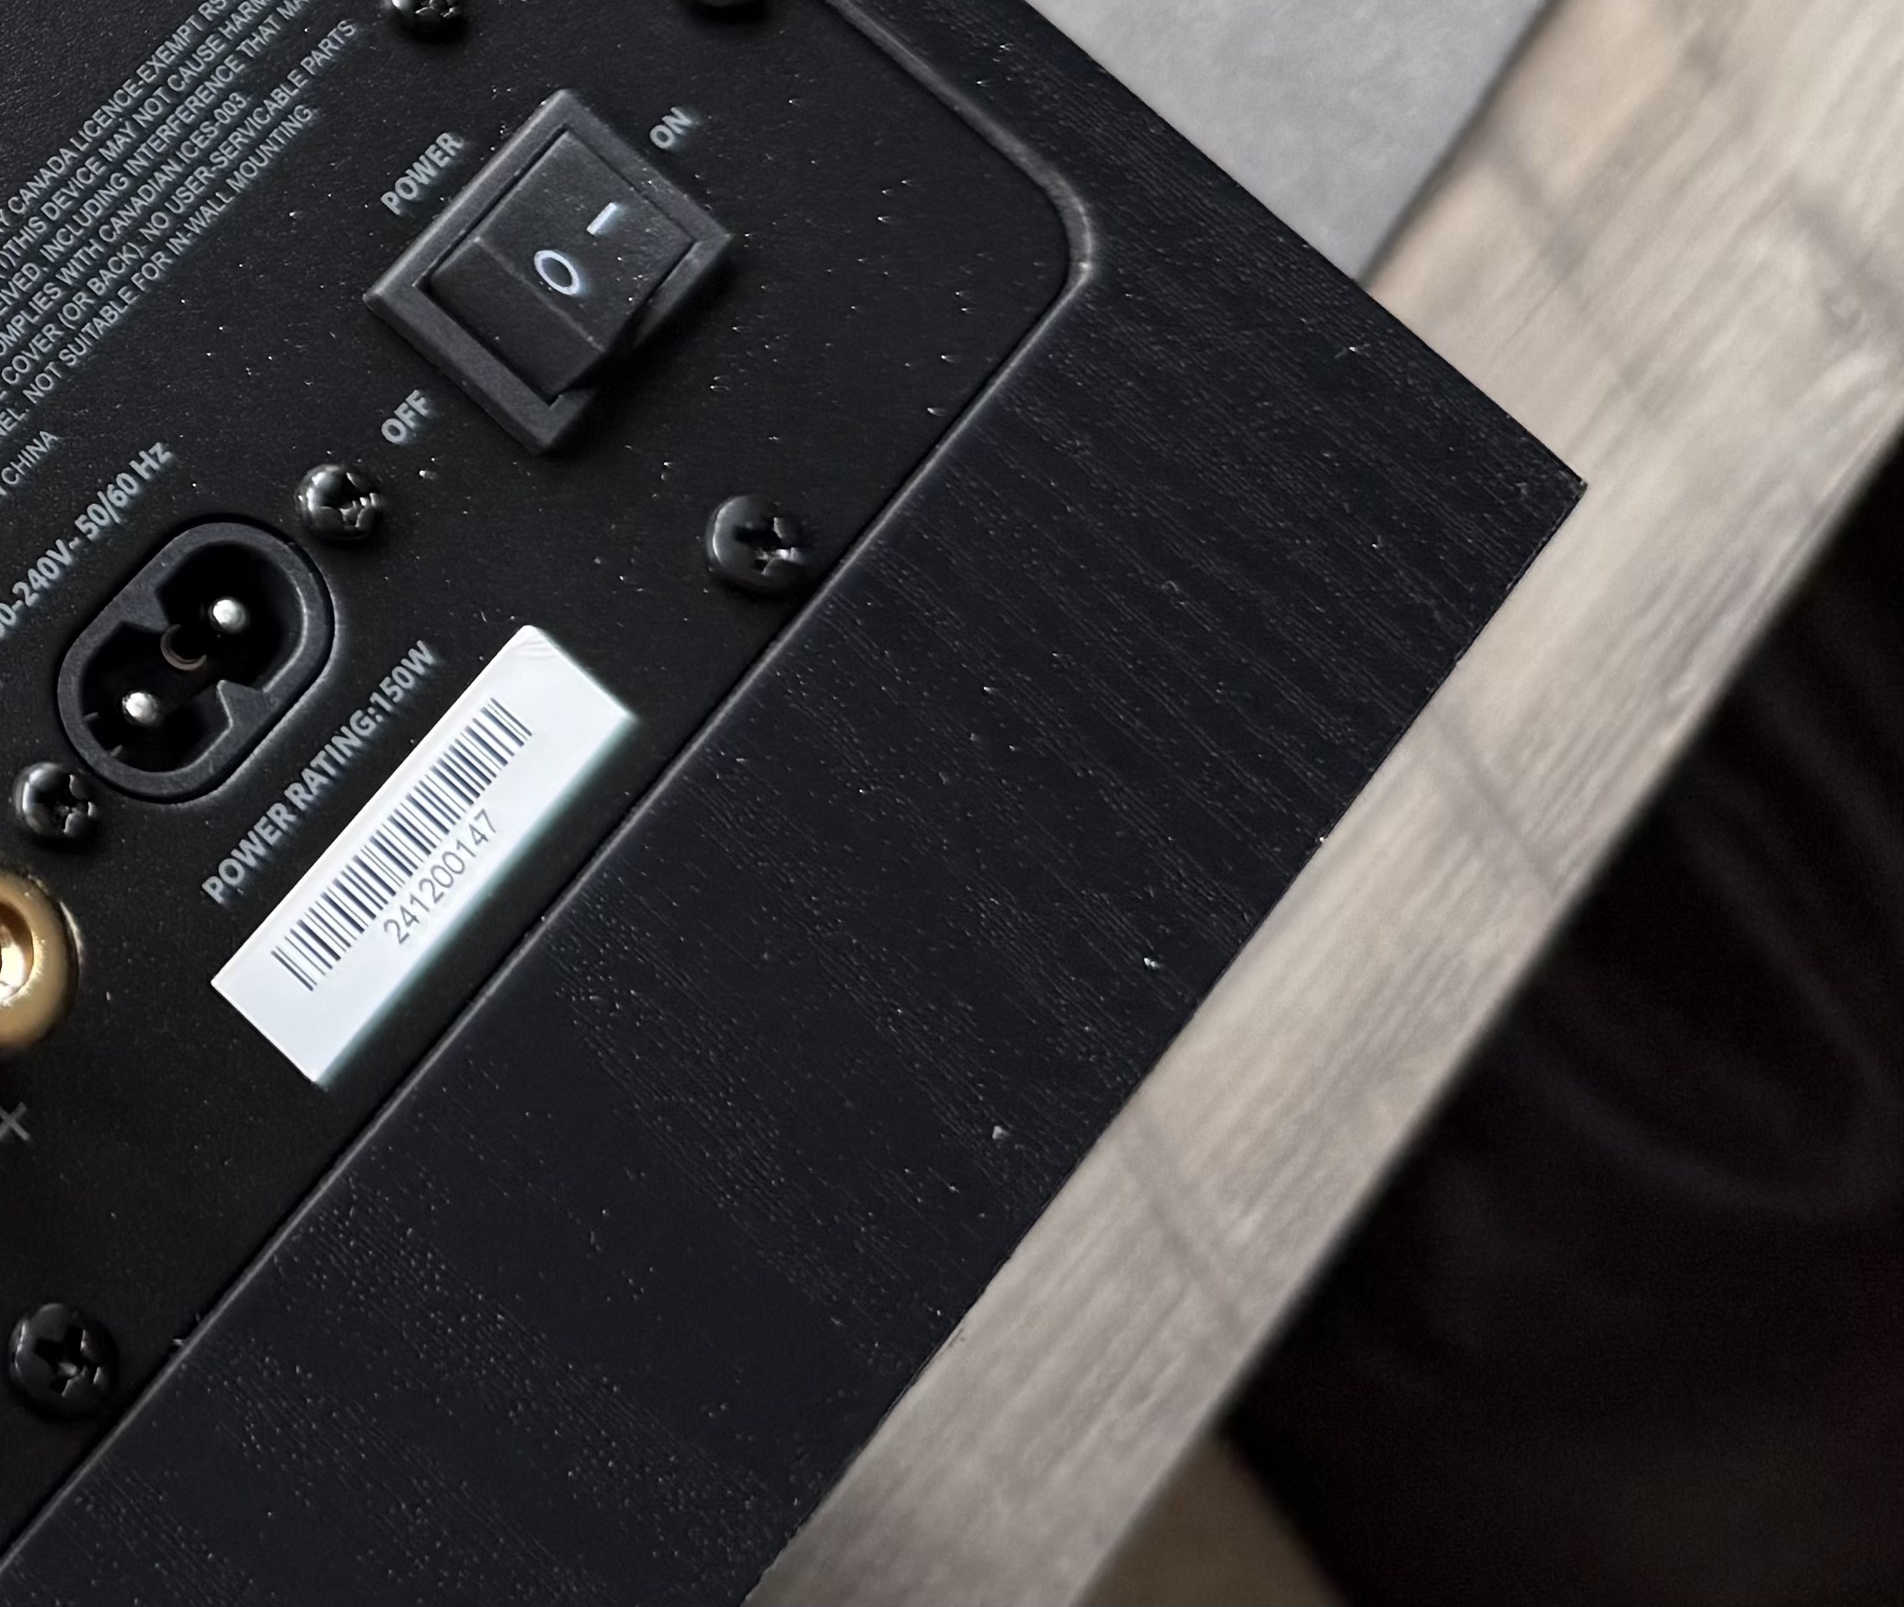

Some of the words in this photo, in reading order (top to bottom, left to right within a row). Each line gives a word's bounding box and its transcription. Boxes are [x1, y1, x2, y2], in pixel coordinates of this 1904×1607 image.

[7, 147, 79, 214] CANADA
[68, 14, 203, 152] LICENCE-EXEMPT
[39, 171, 130, 263] INCLUDING
[122, 54, 246, 176] INTERFERENCE
[236, 14, 281, 57] THAT
[40, 155, 107, 221] DEVICE
[97, 120, 137, 162] MAY
[131, 86, 171, 128] NOT
[166, 33, 227, 92] CAUSE
[379, 130, 465, 218] POWER
[648, 106, 697, 152] ON
[0, 322, 64, 385] COVER
[57, 290, 96, 330] (OR
[138, 210, 170, 242] NO
[163, 68, 309, 214] USER-SERVICABLE
[299, 19, 357, 75] PARTS
[54, 238, 105, 286] WITH
[21, 360, 62, 404] NOT
[57, 285, 138, 367] SUITABLE
[129, 250, 173, 291] FOR
[164, 191, 235, 256] IN-WALL
[0, 430, 60, 486] CHINA
[380, 388, 433, 446] OFF
[74, 471, 140, 541] 50/60
[128, 441, 173, 480] Hz
[201, 802, 297, 904] POWER
[283, 639, 436, 811] RATING:150W
[382, 807, 496, 945] 241200147
